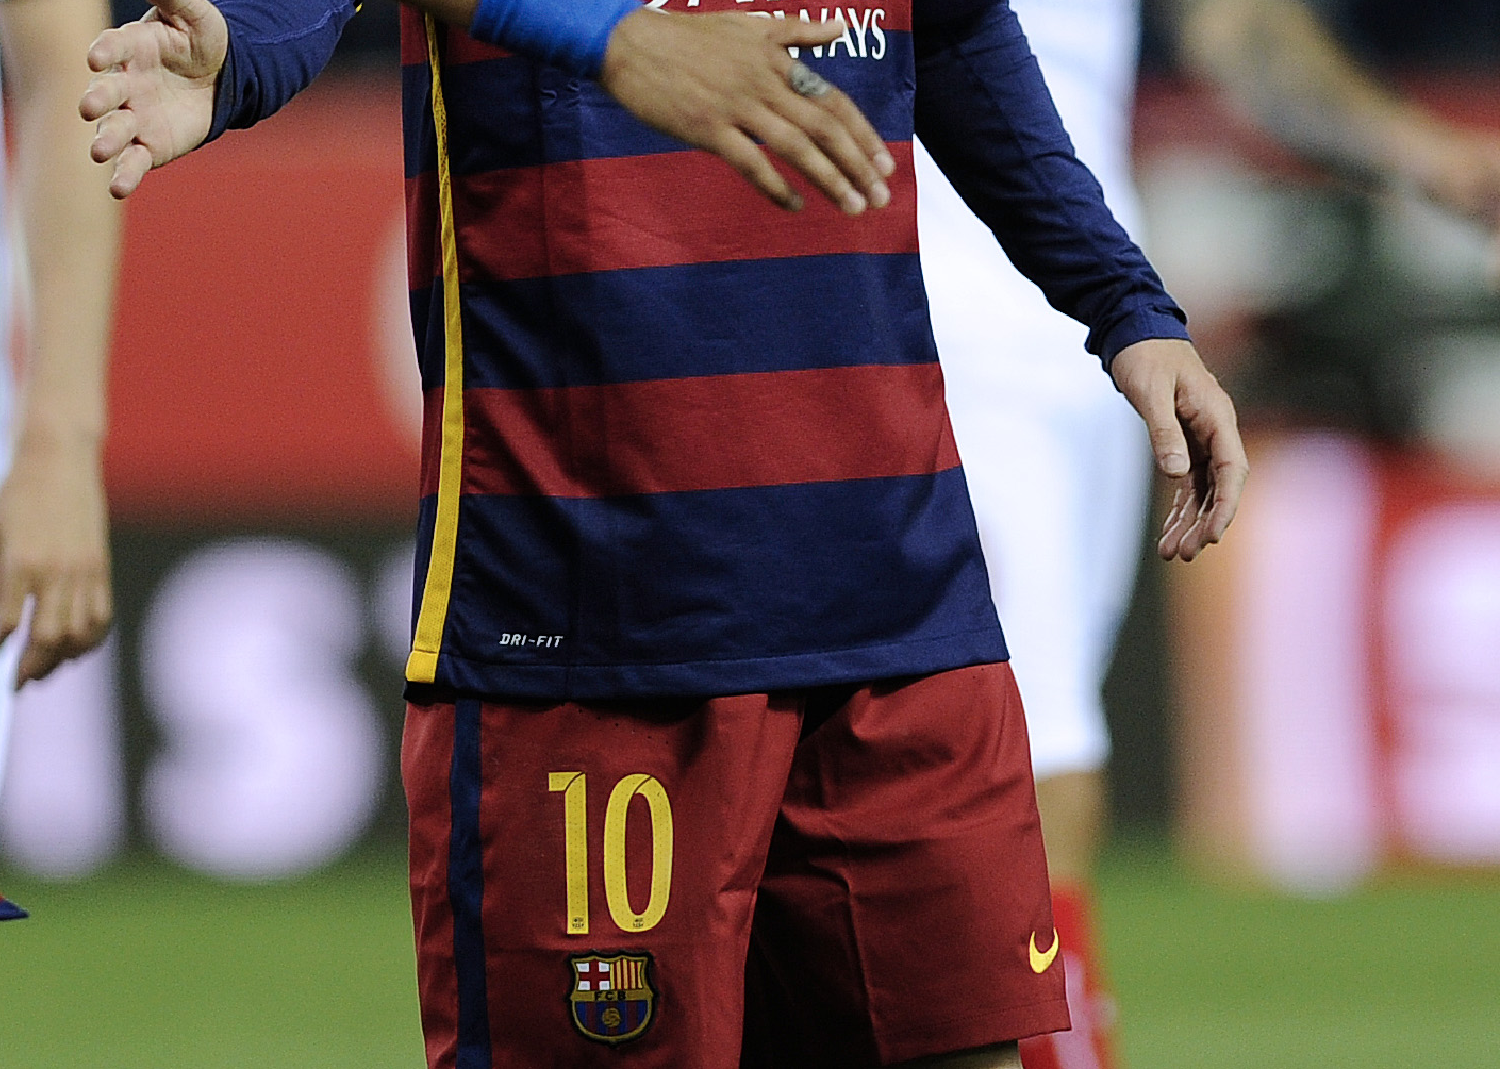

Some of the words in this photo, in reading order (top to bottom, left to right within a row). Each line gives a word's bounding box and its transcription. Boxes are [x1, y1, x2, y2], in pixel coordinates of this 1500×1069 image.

[499, 633, 564, 648] DRI-FIT
[548, 771, 673, 934] 10
[594, 988, 627, 1002] FCB
